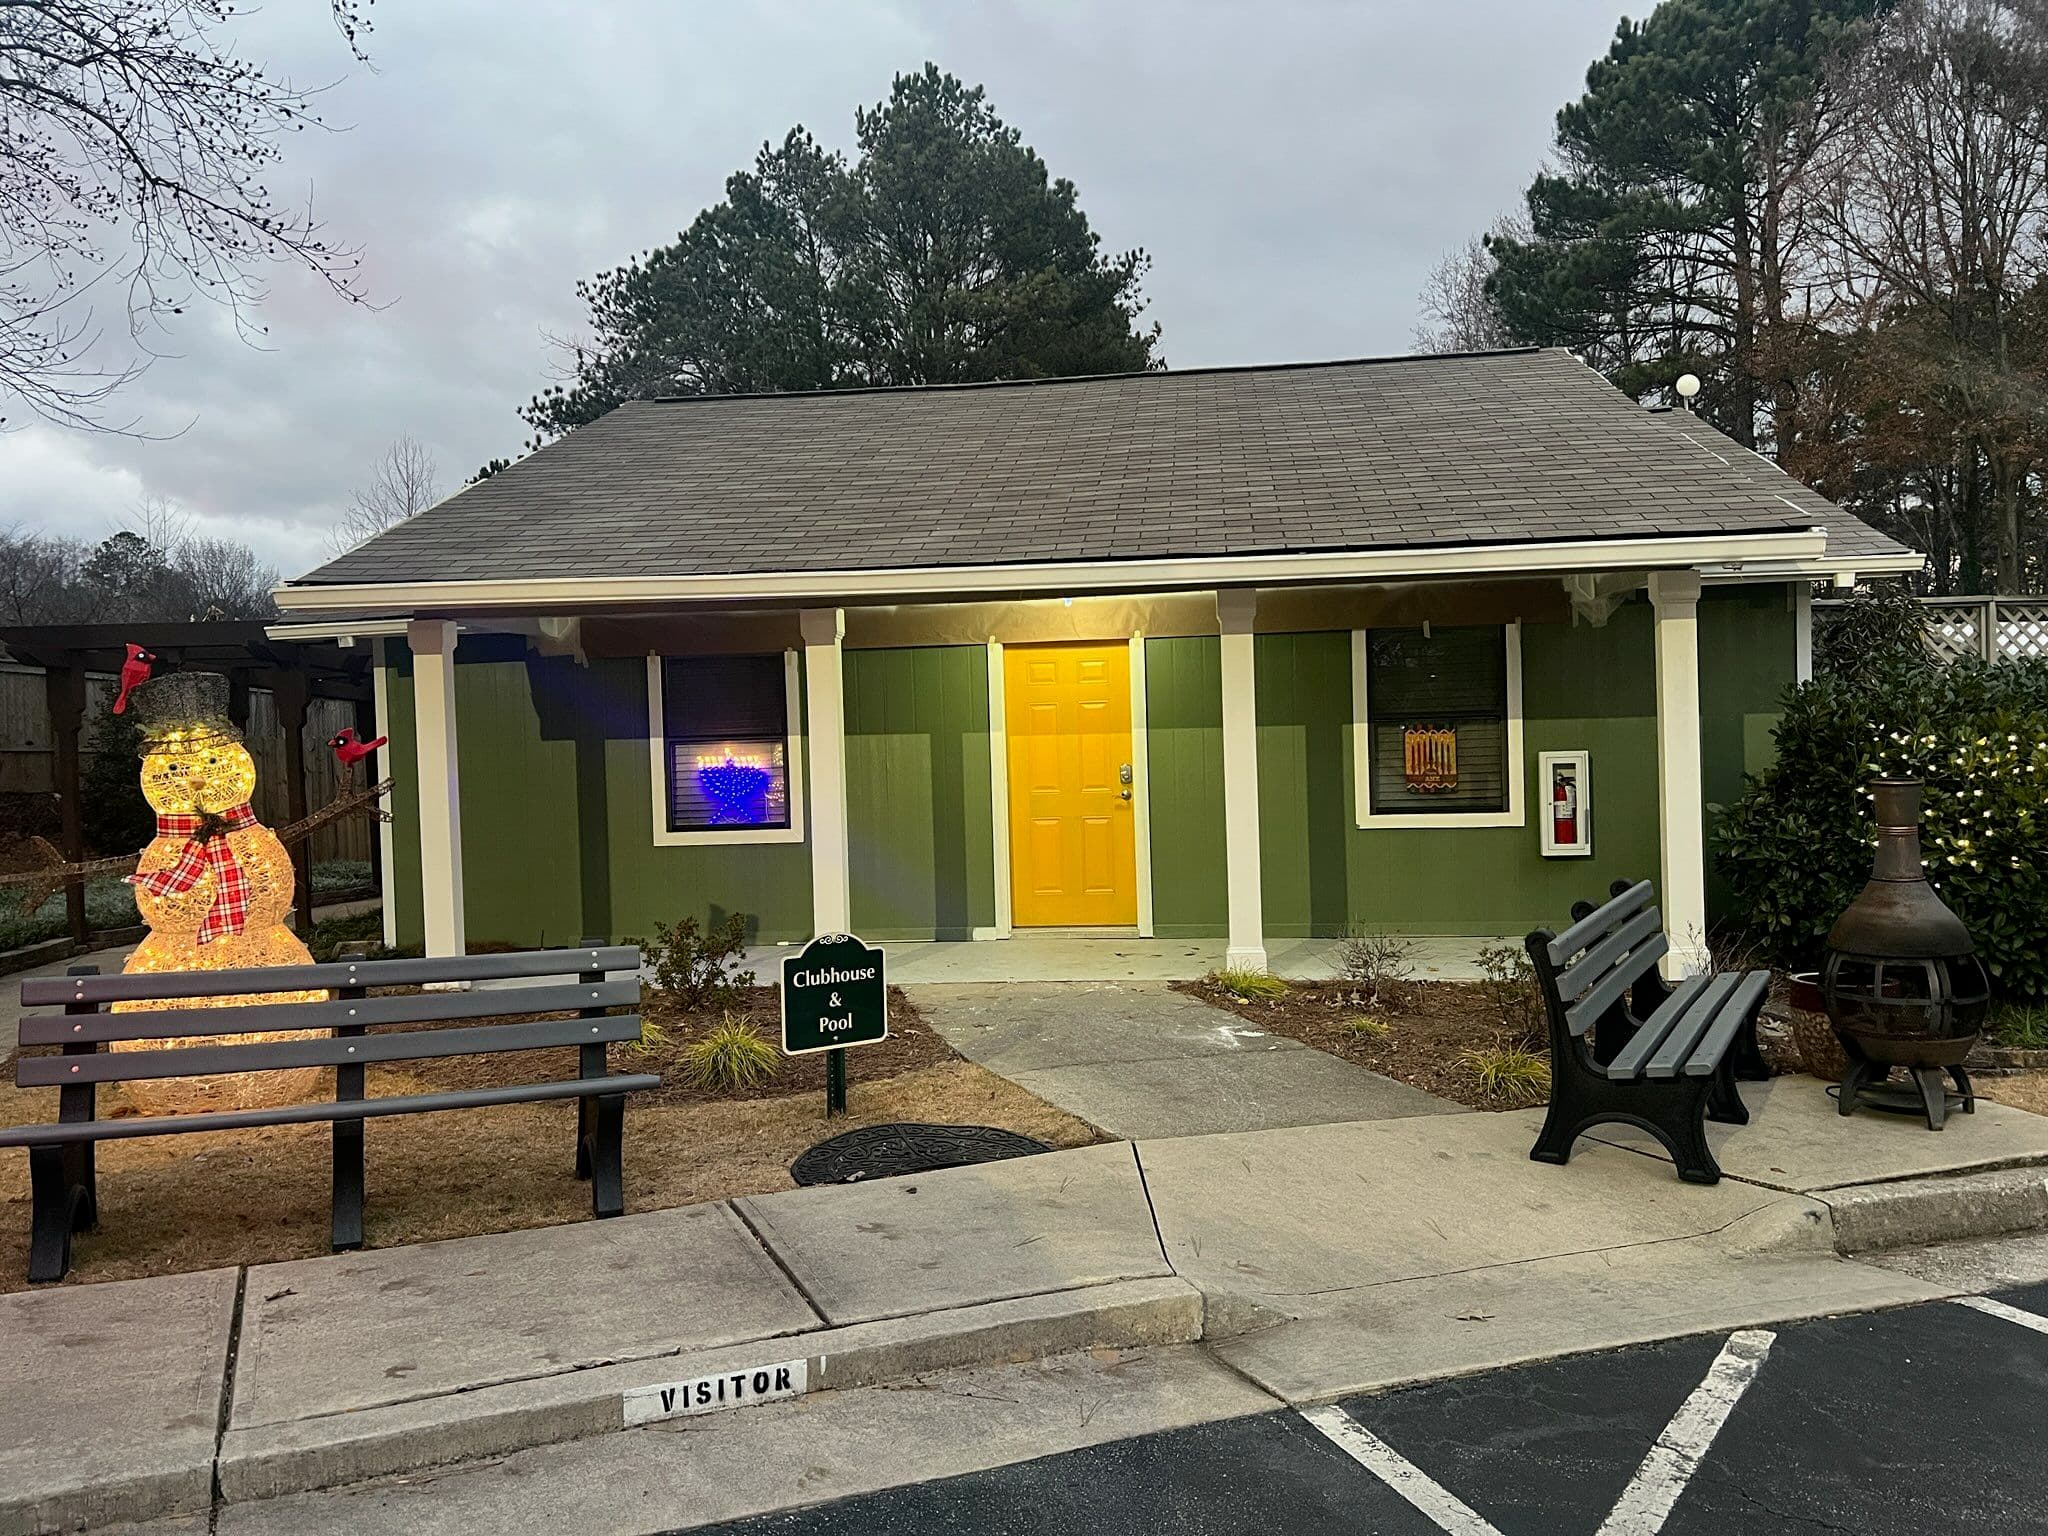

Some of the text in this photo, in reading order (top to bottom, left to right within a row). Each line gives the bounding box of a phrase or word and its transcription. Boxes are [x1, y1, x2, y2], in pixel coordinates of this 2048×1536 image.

[793, 966, 875, 988] Clubhouse
[829, 991, 842, 1008] &
[819, 1012, 853, 1033] Pool
[660, 1367, 791, 1413] VISITOR
